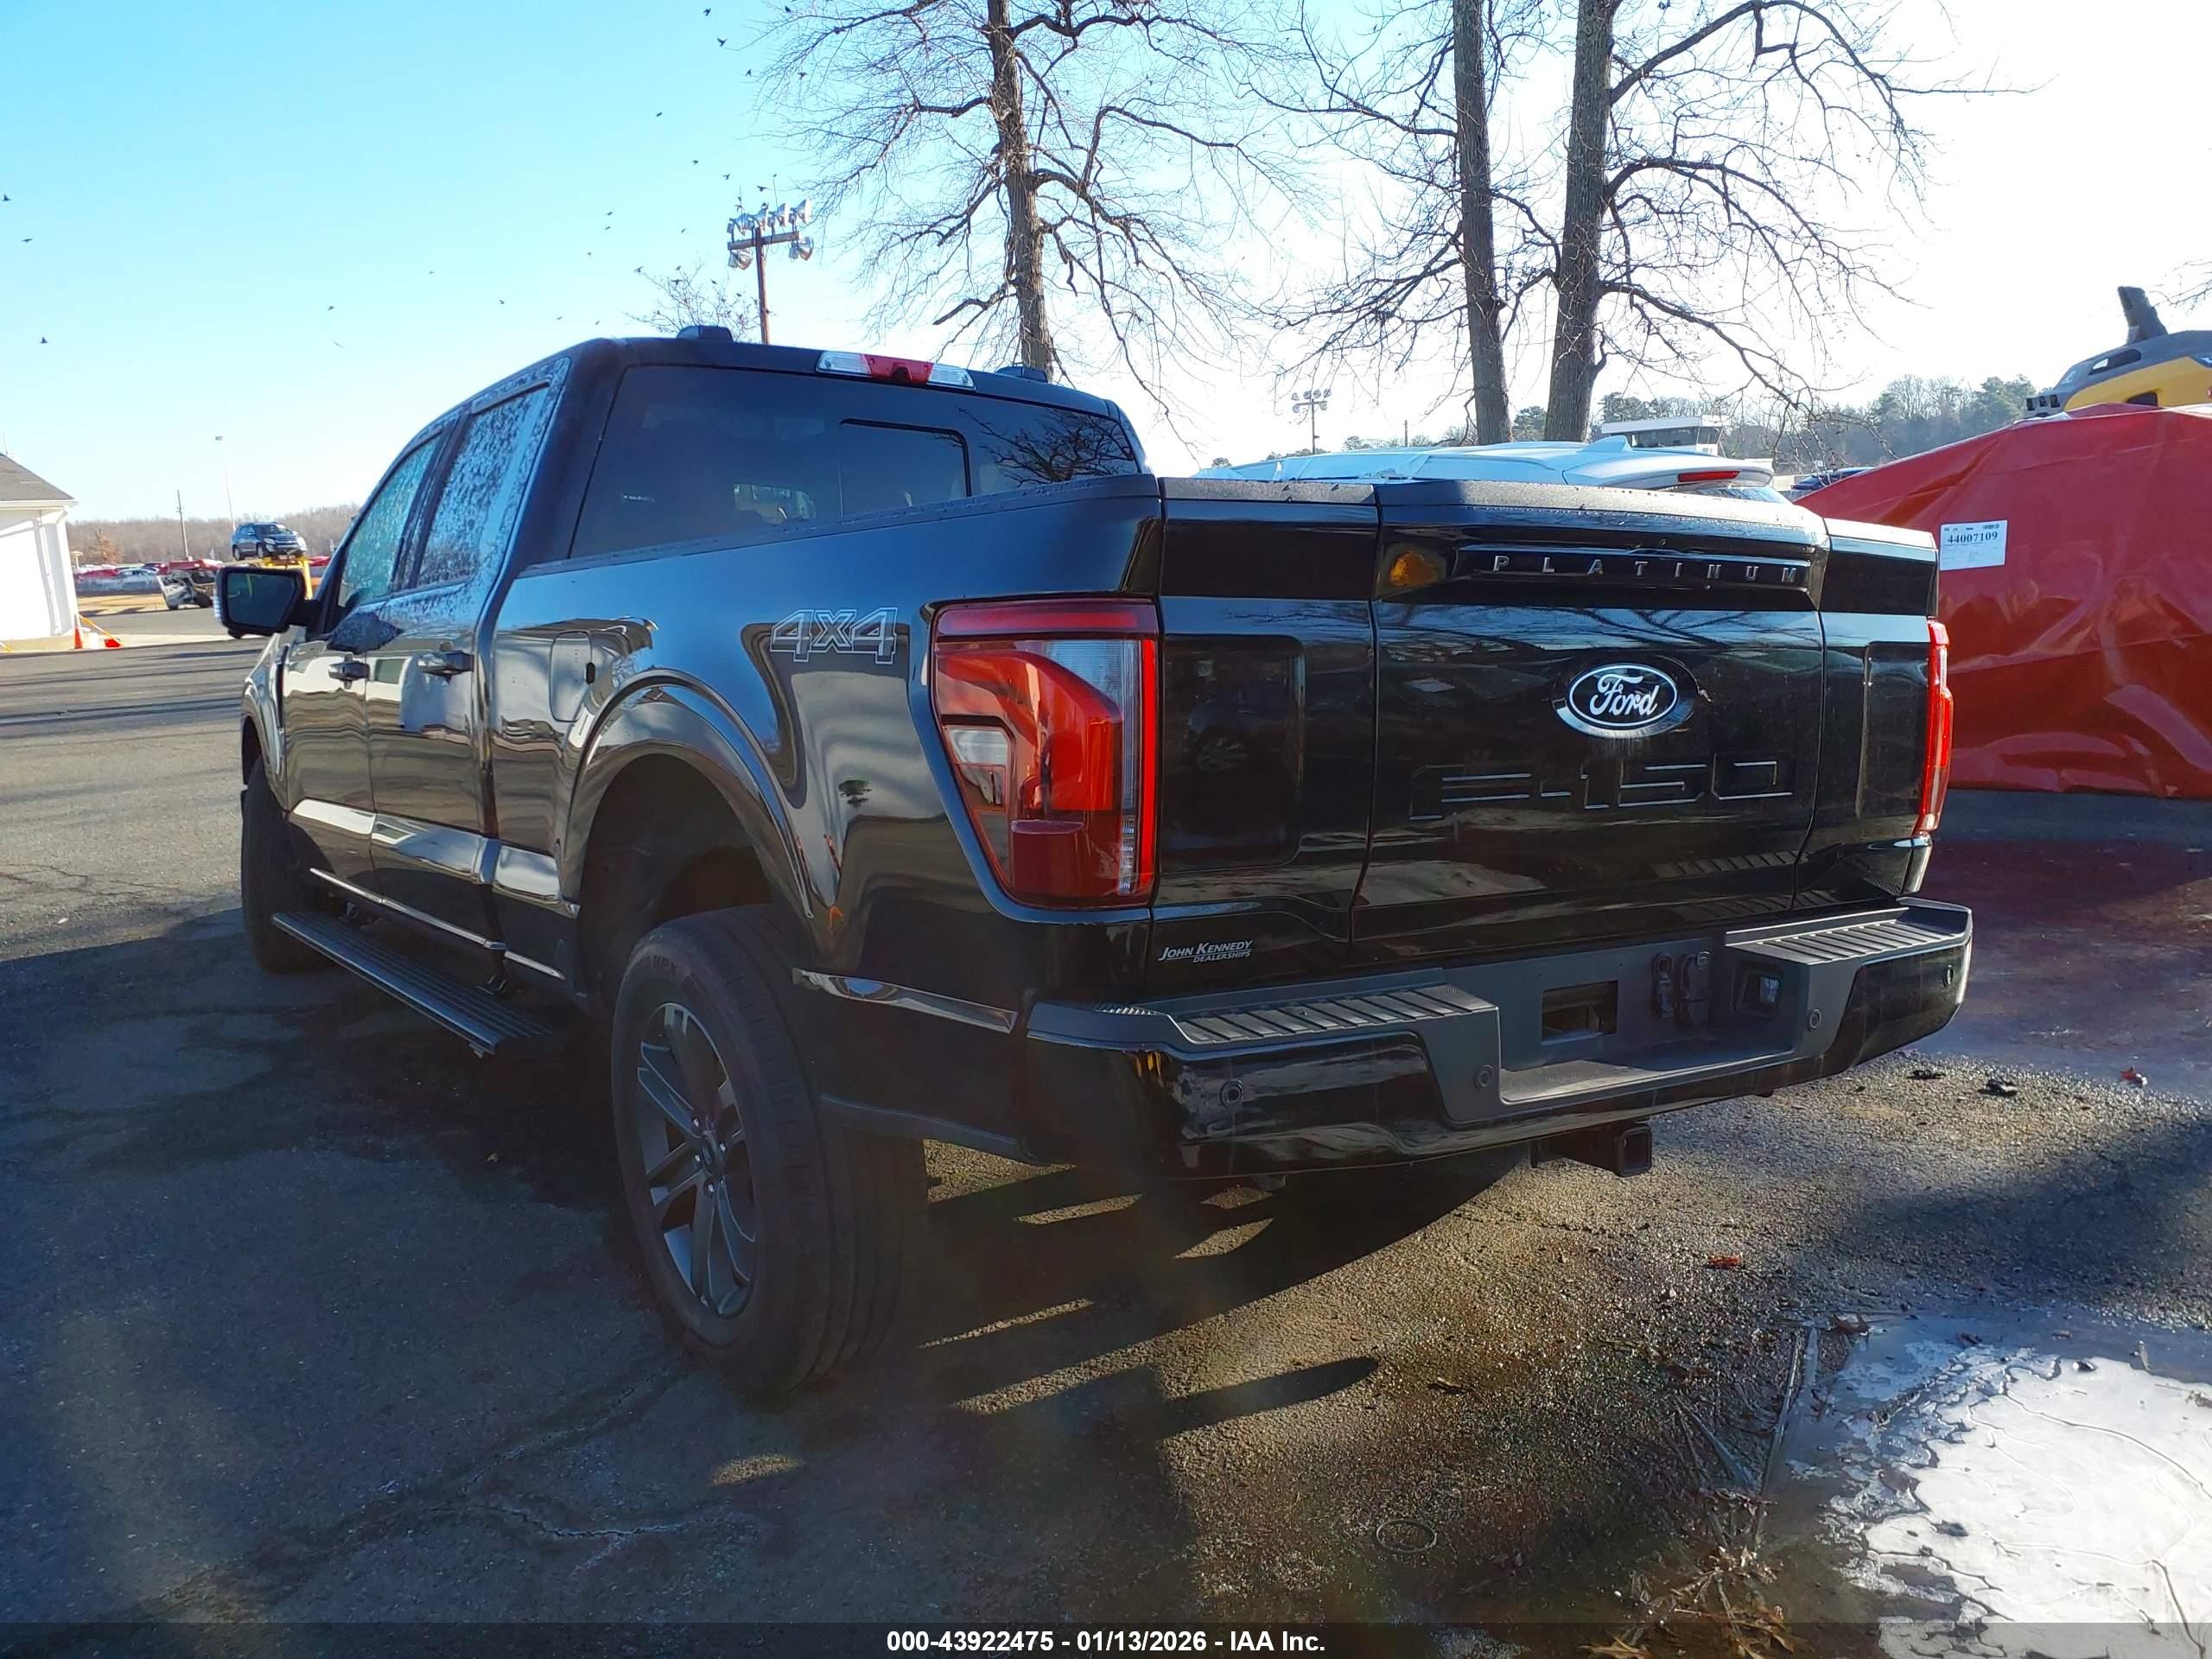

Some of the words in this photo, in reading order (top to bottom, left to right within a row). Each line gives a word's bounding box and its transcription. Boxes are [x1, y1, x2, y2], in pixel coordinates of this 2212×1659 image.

[1947, 531, 1999, 544] 44007109
[1493, 555, 1797, 583] PLATINUM
[1589, 673, 1661, 716] Ford
[1158, 946, 1194, 962] JOHN
[1196, 940, 1253, 955] KENNEDY
[1192, 950, 1252, 963] DEALERSHIPS
